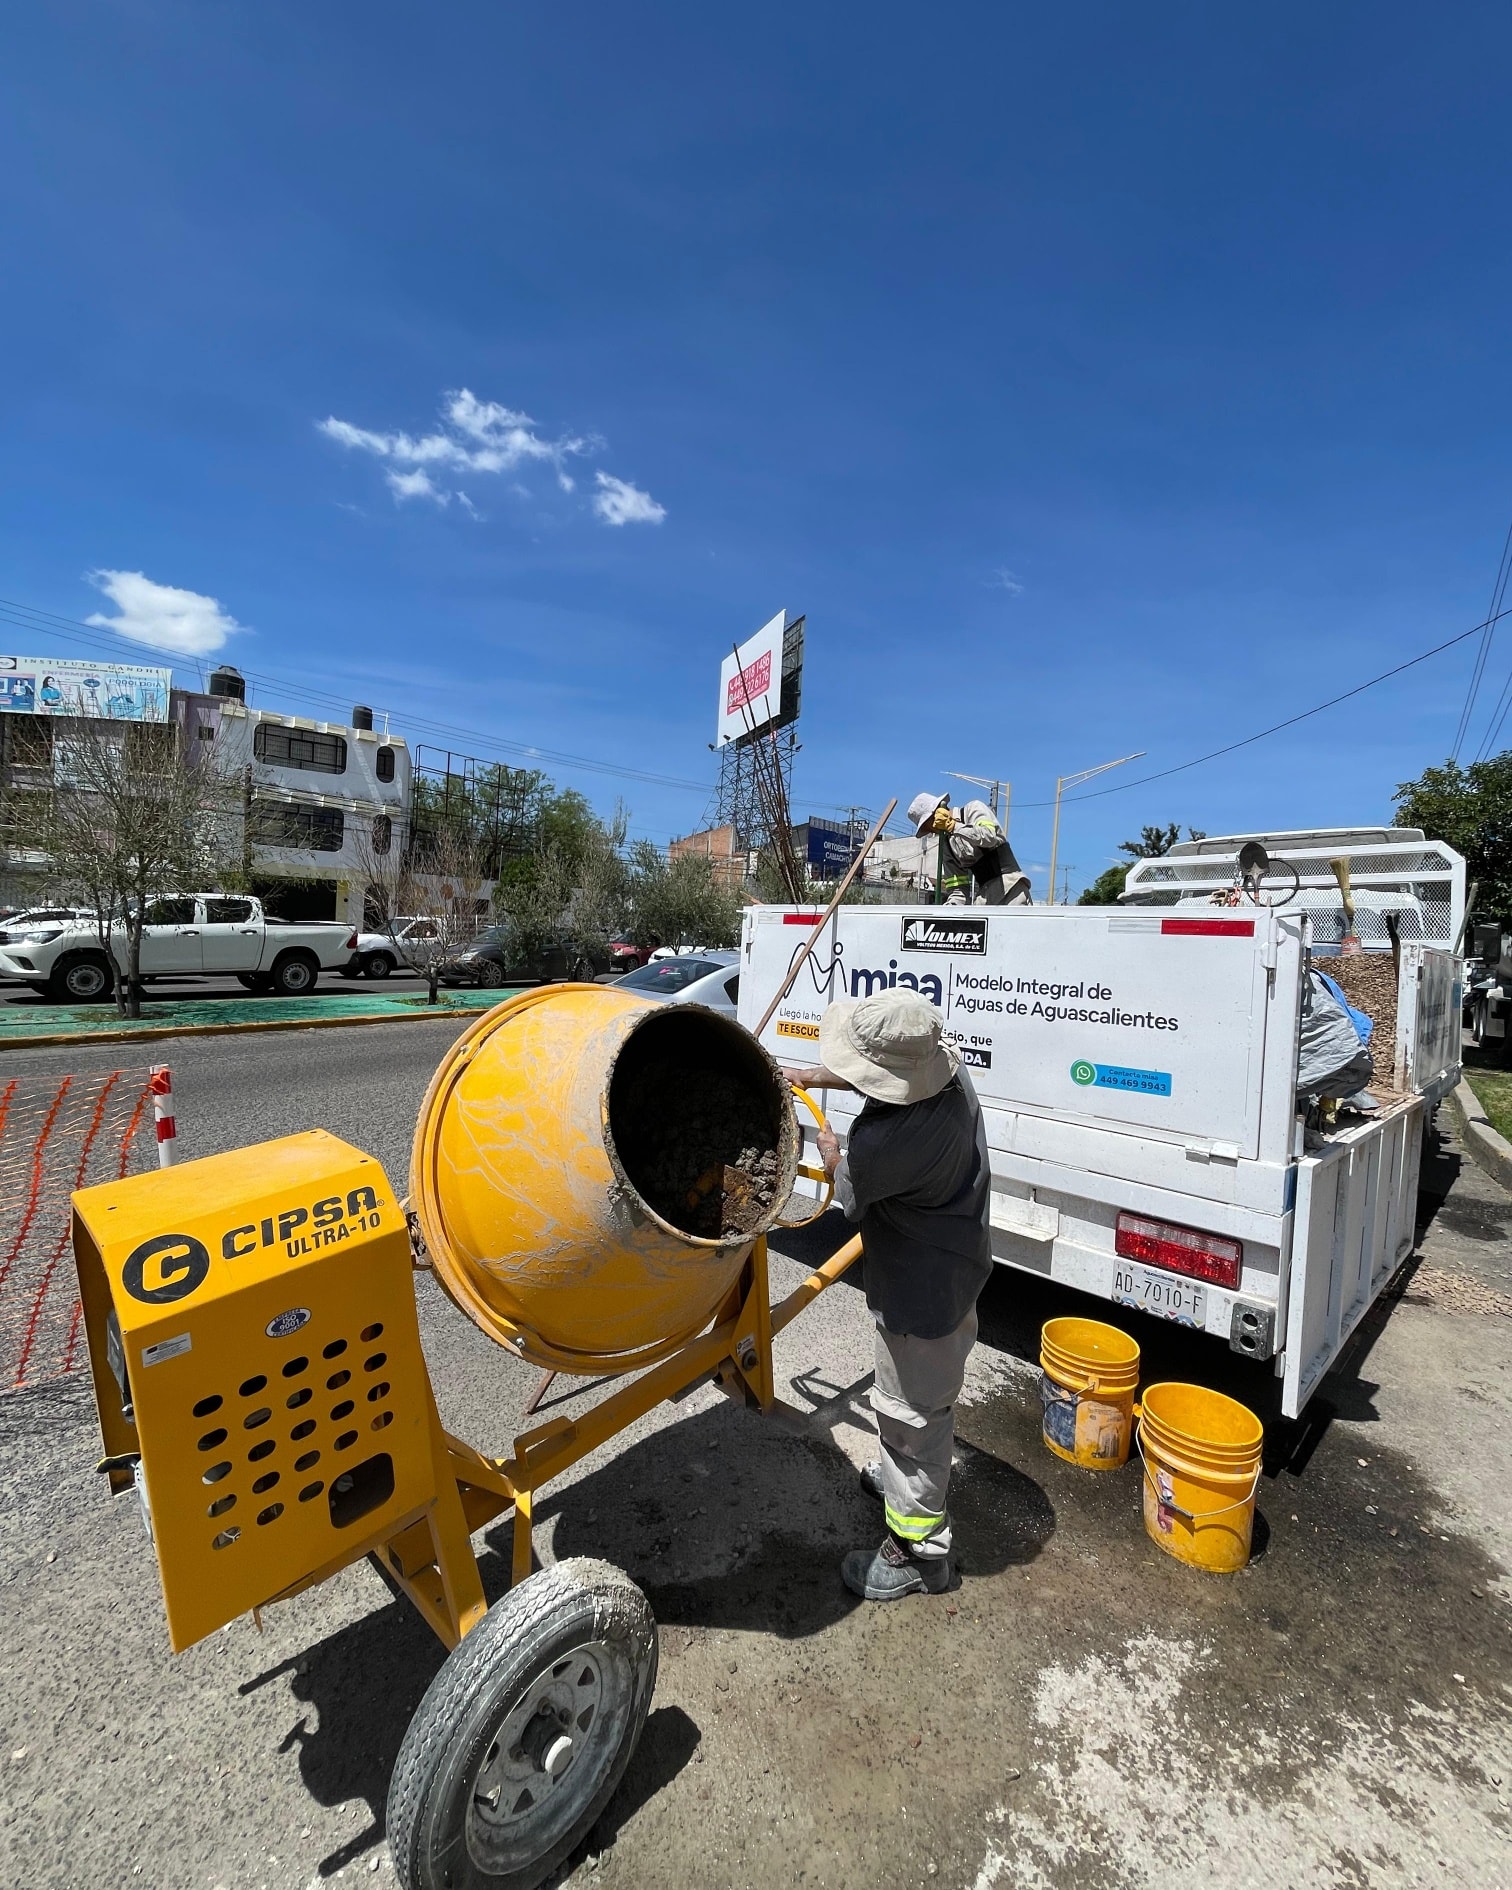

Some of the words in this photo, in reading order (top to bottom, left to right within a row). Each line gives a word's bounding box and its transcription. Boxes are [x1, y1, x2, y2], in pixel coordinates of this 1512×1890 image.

[24, 658, 97, 669] INSTITUTO
[915, 921, 984, 944] VOLMEX
[851, 959, 943, 1007] miaa
[956, 973, 1013, 992] Modelo
[1016, 977, 1084, 1000] Integral
[1087, 983, 1112, 1000] de
[955, 994, 1003, 1013] Aguas
[1006, 999, 1028, 1015] de
[1031, 1001, 1179, 1031] Aguascalientes
[779, 1008, 802, 1020] Llegó
[802, 1011, 810, 1020] la
[970, 1035, 993, 1047] que
[779, 1023, 789, 1033] TE
[790, 1025, 820, 1038] ESCUC
[1100, 1076, 1118, 1085] 449
[1120, 1079, 1139, 1088] 469
[1141, 1081, 1166, 1092] 9943
[222, 1186, 377, 1260] CIPSA
[286, 1212, 381, 1258] ULTRA-10
[1115, 1271, 1203, 1314] AD-7010-F
[279, 1318, 299, 1331] 9001
[282, 1314, 297, 1325] ISO
